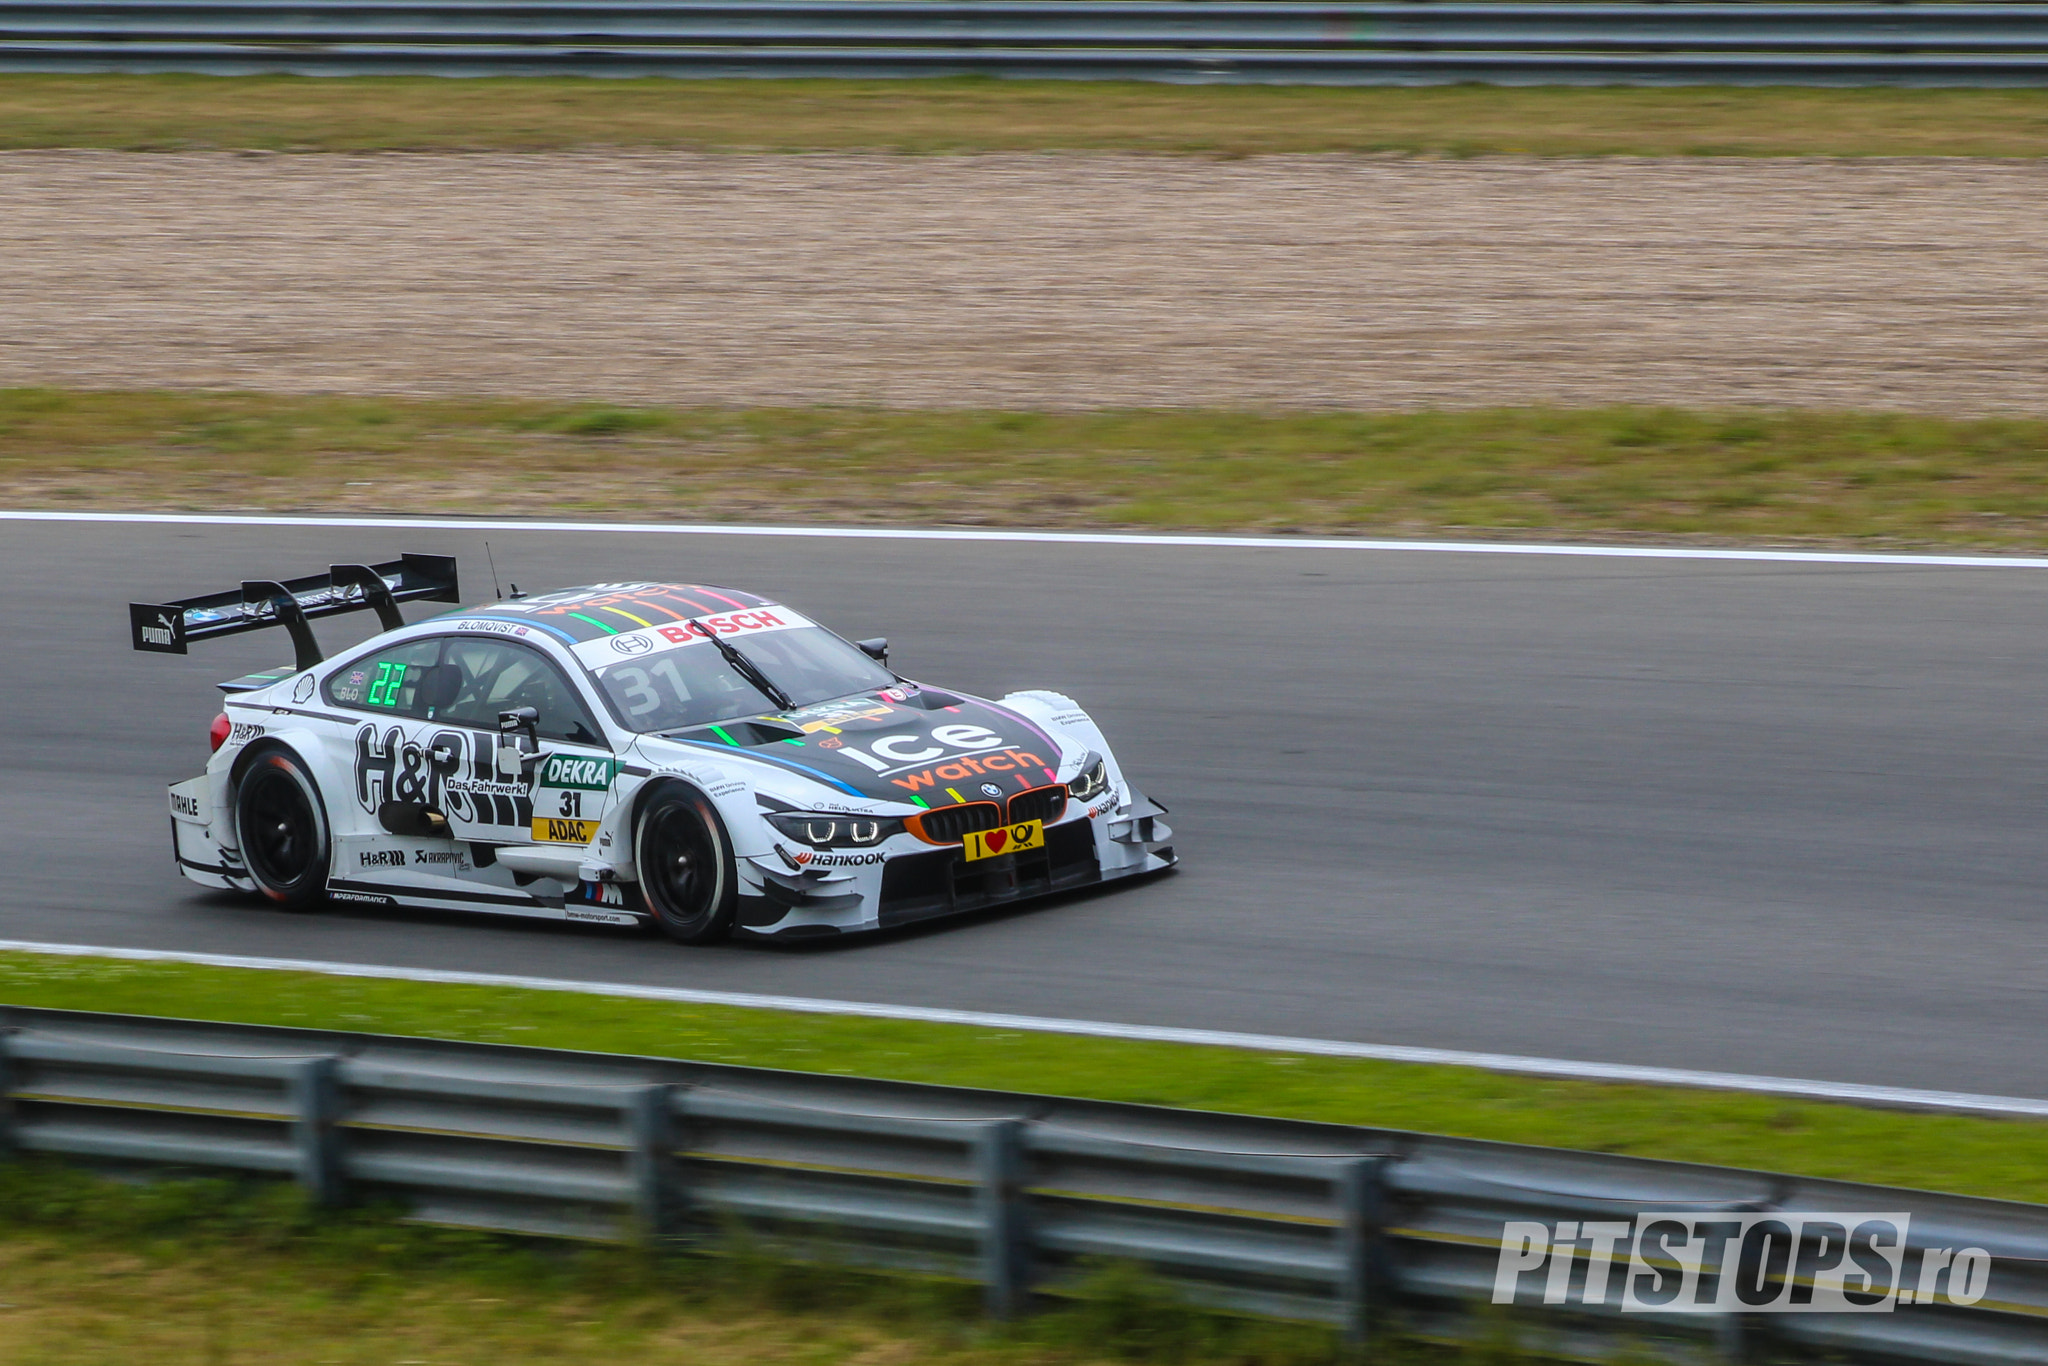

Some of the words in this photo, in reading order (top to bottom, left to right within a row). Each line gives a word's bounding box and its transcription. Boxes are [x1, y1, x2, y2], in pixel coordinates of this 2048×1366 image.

[141, 625, 172, 646] PUMA
[457, 621, 517, 634] BLOMQVIST
[656, 610, 786, 644] BOSCH
[340, 687, 359, 701] BLO
[367, 662, 407, 706] 22
[611, 658, 693, 716] 31
[231, 722, 253, 741] H&R
[354, 722, 474, 823] H&R
[547, 757, 607, 786] DEKRA
[890, 747, 1046, 792] watch
[447, 779, 469, 791] Das
[471, 780, 528, 796] Fahrwerk!
[558, 791, 582, 818] 31
[548, 820, 588, 843] ADAC
[360, 850, 388, 867] H&R
